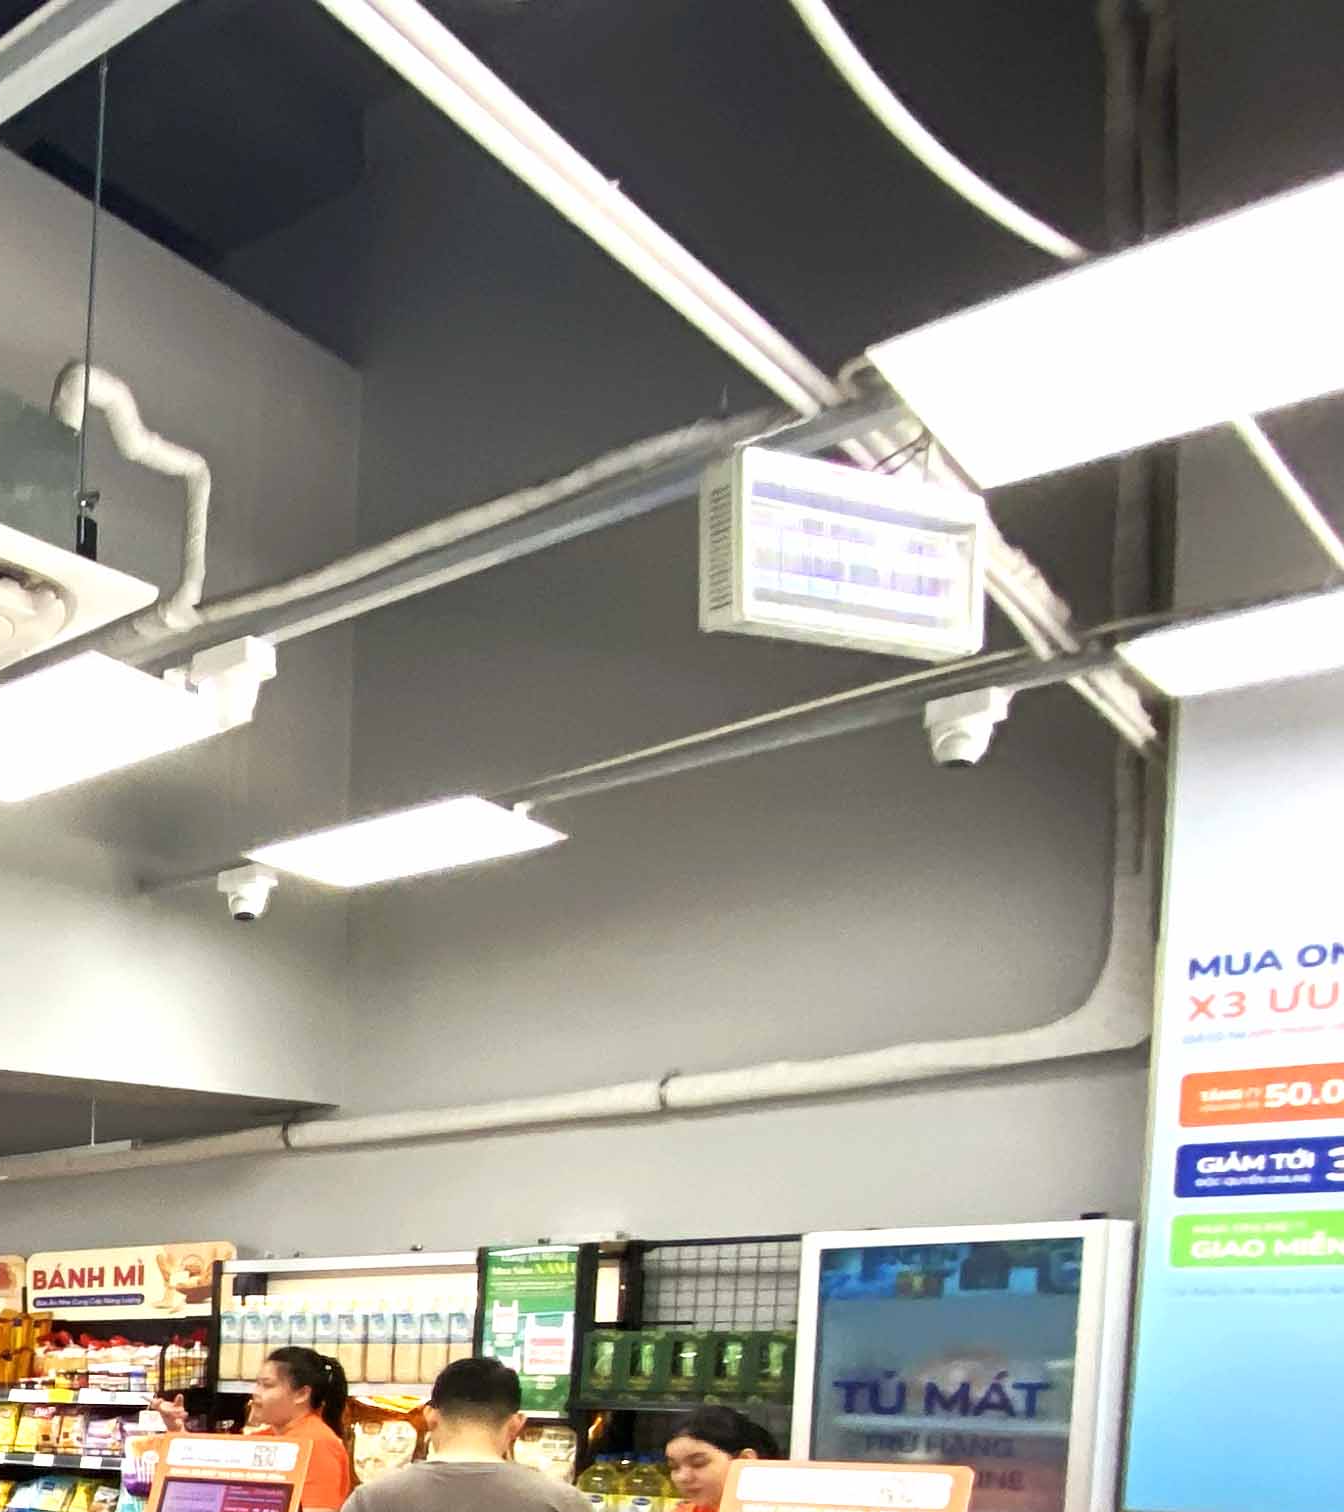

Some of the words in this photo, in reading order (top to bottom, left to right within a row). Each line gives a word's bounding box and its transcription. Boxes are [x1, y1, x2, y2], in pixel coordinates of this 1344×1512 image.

[1188, 949, 1283, 981] MUA
[1189, 991, 1247, 1021] X3
[1196, 1151, 1266, 1175] GIẢM
[1269, 1148, 1316, 1170] TỚI
[1191, 1239, 1265, 1260] GIAO
[32, 1262, 105, 1291] BÁNH
[113, 1258, 145, 1288] MÌ
[832, 1370, 907, 1416] TỦ
[923, 1370, 1051, 1419] MÁT
